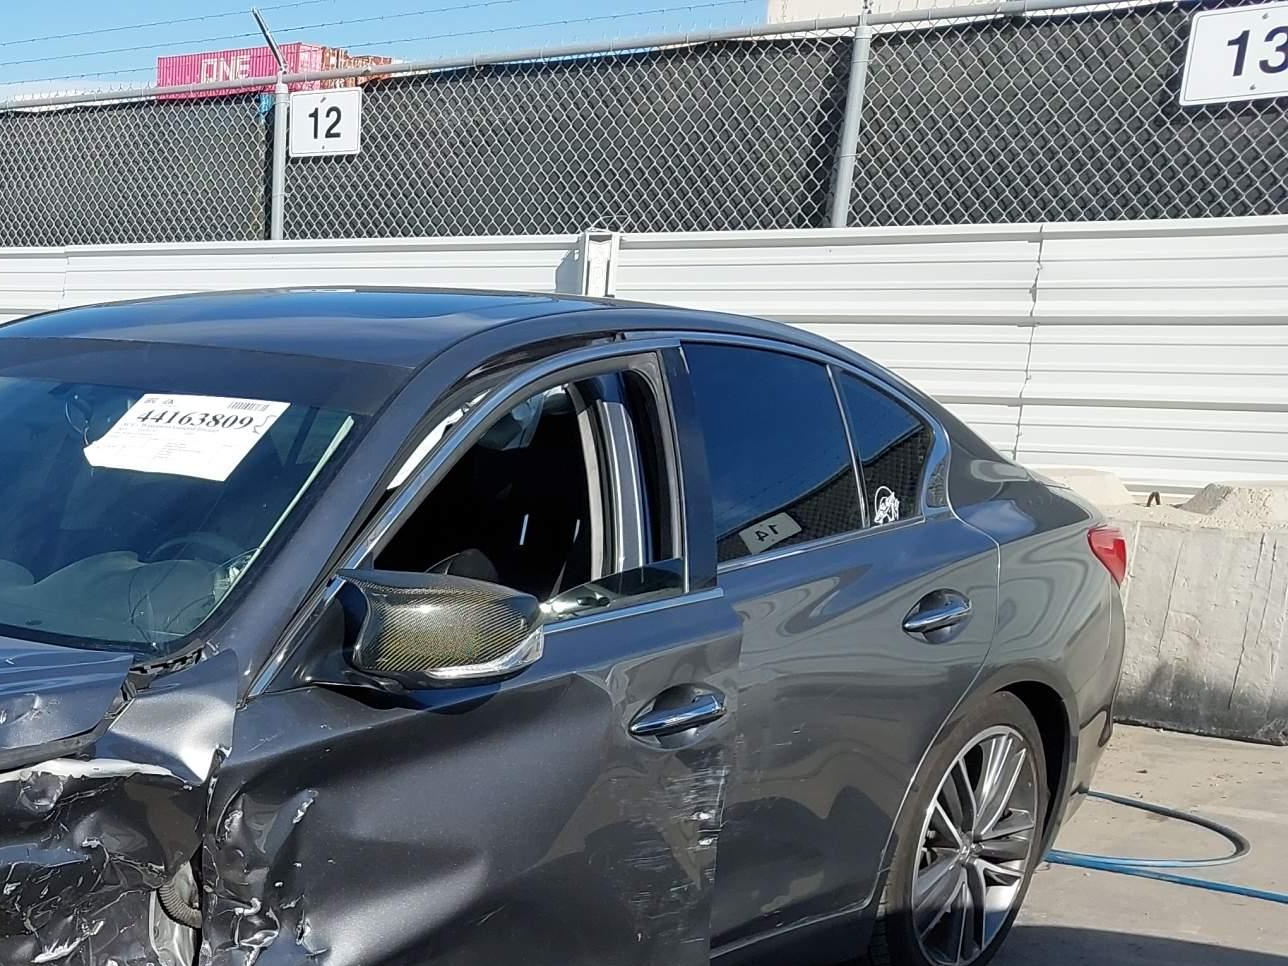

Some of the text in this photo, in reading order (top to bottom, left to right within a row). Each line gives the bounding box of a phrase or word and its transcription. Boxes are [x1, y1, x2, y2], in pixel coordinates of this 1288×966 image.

[1227, 25, 1288, 77] 13
[201, 55, 251, 85] ONE
[308, 106, 342, 139] 12
[137, 409, 254, 429] 44163809
